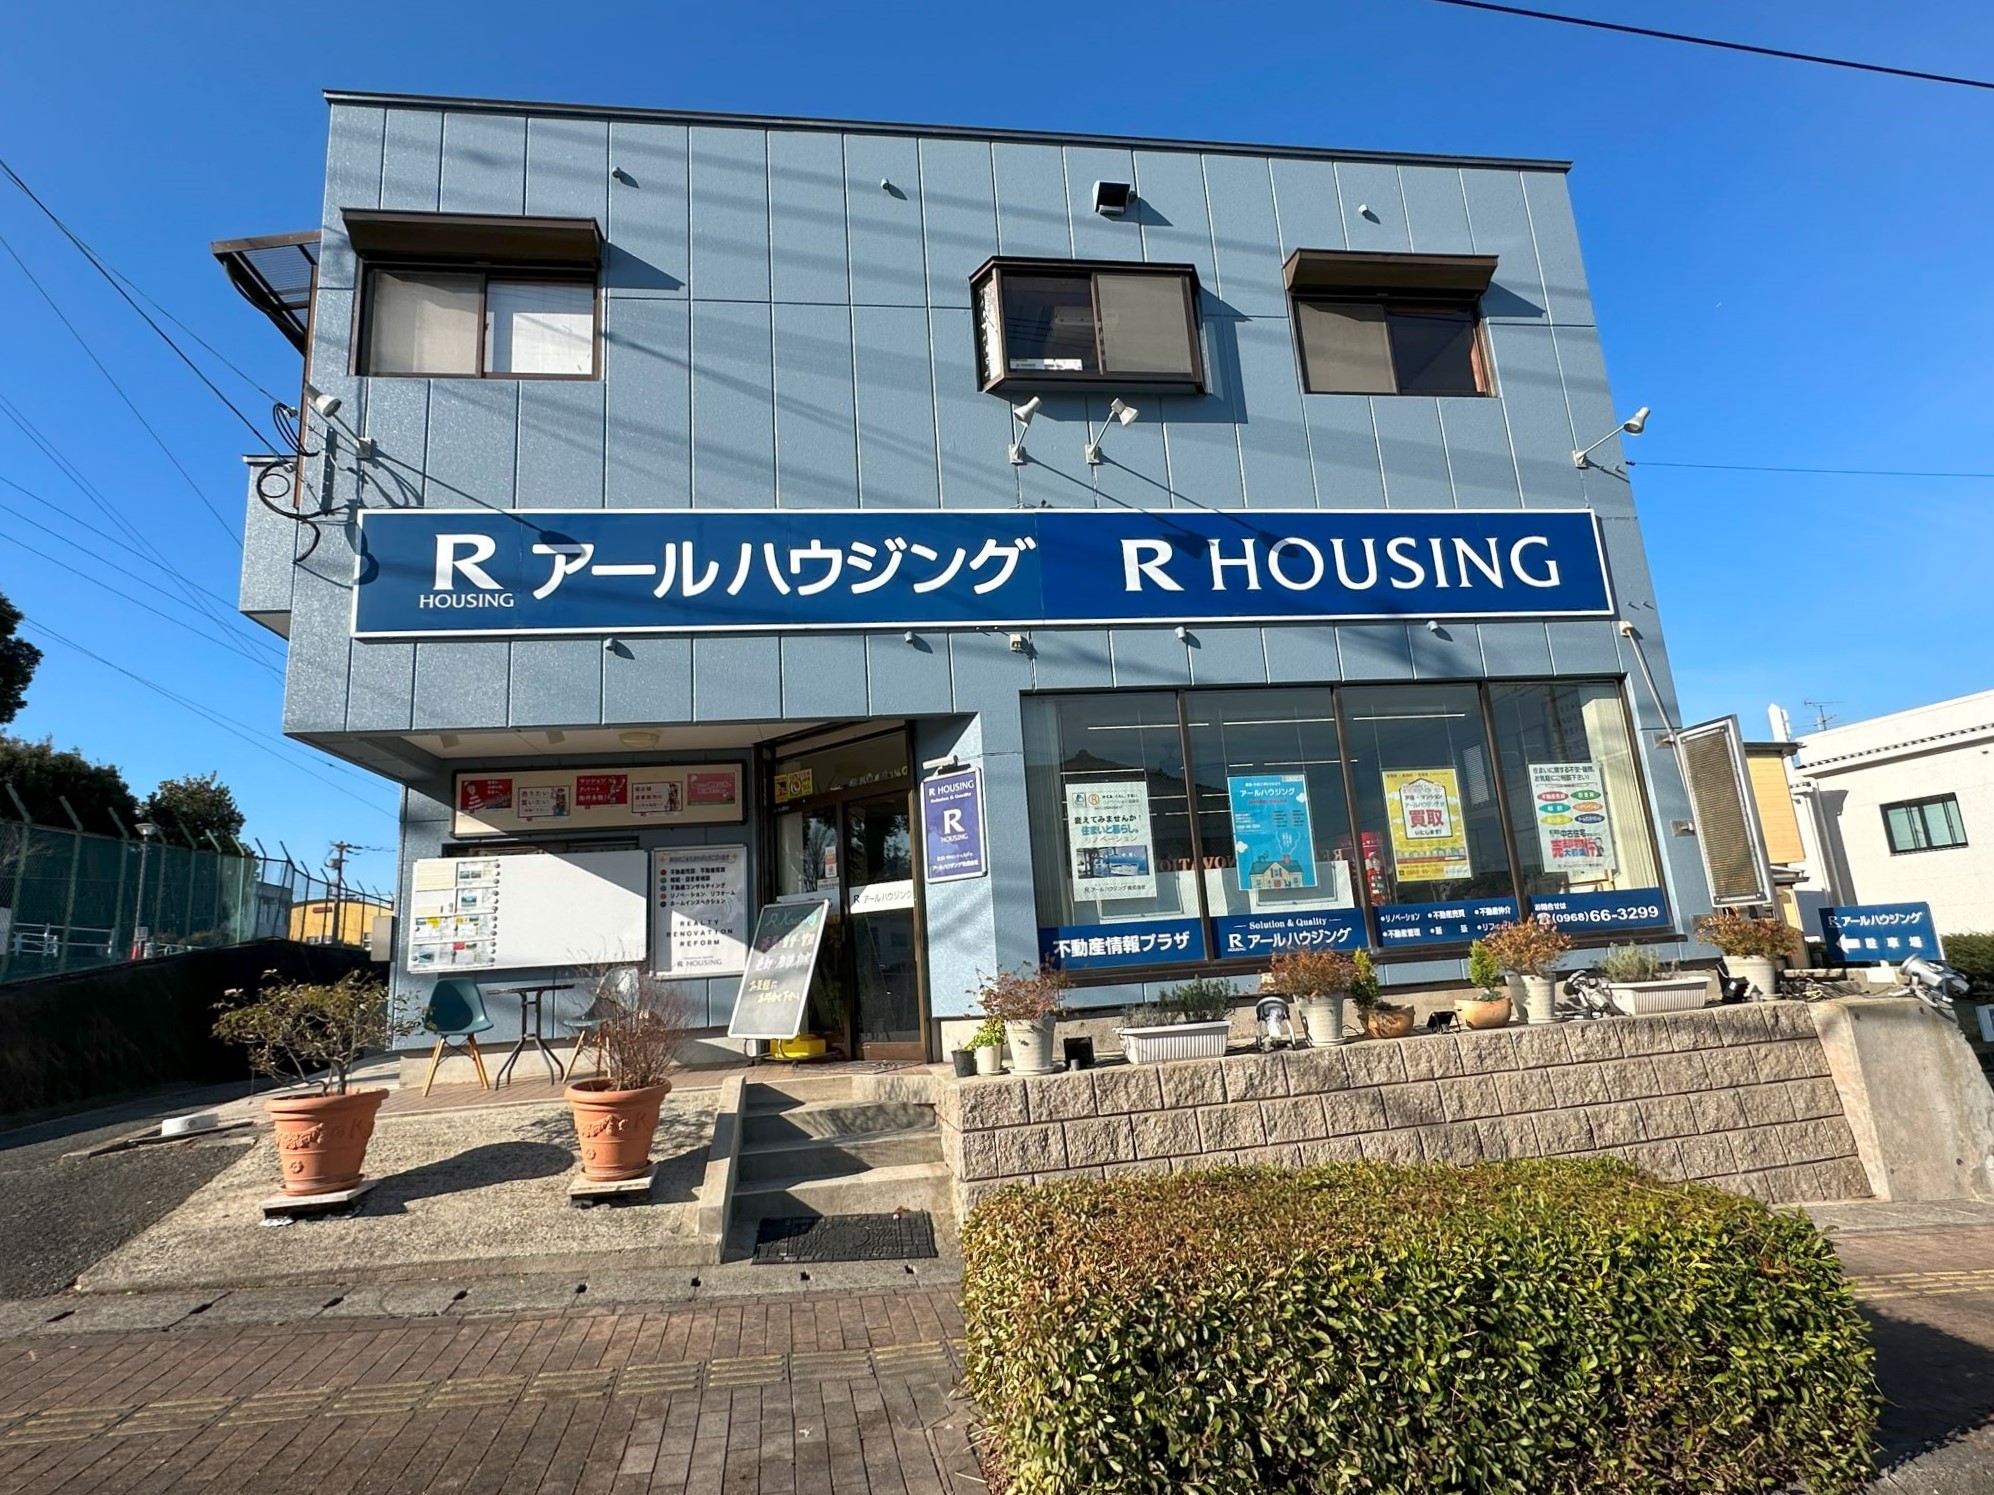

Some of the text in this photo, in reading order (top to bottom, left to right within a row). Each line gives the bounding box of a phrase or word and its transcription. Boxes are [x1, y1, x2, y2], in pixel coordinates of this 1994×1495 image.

[433, 533, 504, 590] R
[1121, 537, 1562, 592] R HOUSING
[531, 538, 1037, 602] アールハウジング
[419, 593, 515, 609] HOUSING
[929, 780, 975, 797] R HOUSING
[1239, 787, 1295, 798] アールハウジング
[944, 808, 965, 835] R
[1409, 809, 1444, 828] 買取
[941, 833, 969, 843] HOUSING
[670, 898, 726, 907] ホームインスペクション
[853, 894, 860, 904] R
[1385, 912, 1421, 923] リノベーション
[1552, 905, 1659, 924] (0968)66-3299
[1827, 916, 1842, 928] R
[1841, 912, 1923, 927] アールハウジング
[680, 918, 719, 927] REALTY
[1249, 917, 1328, 930] Solution & Quality
[666, 928, 733, 938] RENOVATION
[1228, 933, 1244, 948] R
[1247, 927, 1352, 949] アールハウジング
[680, 939, 720, 947] REFORM
[1053, 930, 1190, 959] 不動産情報プラザ
